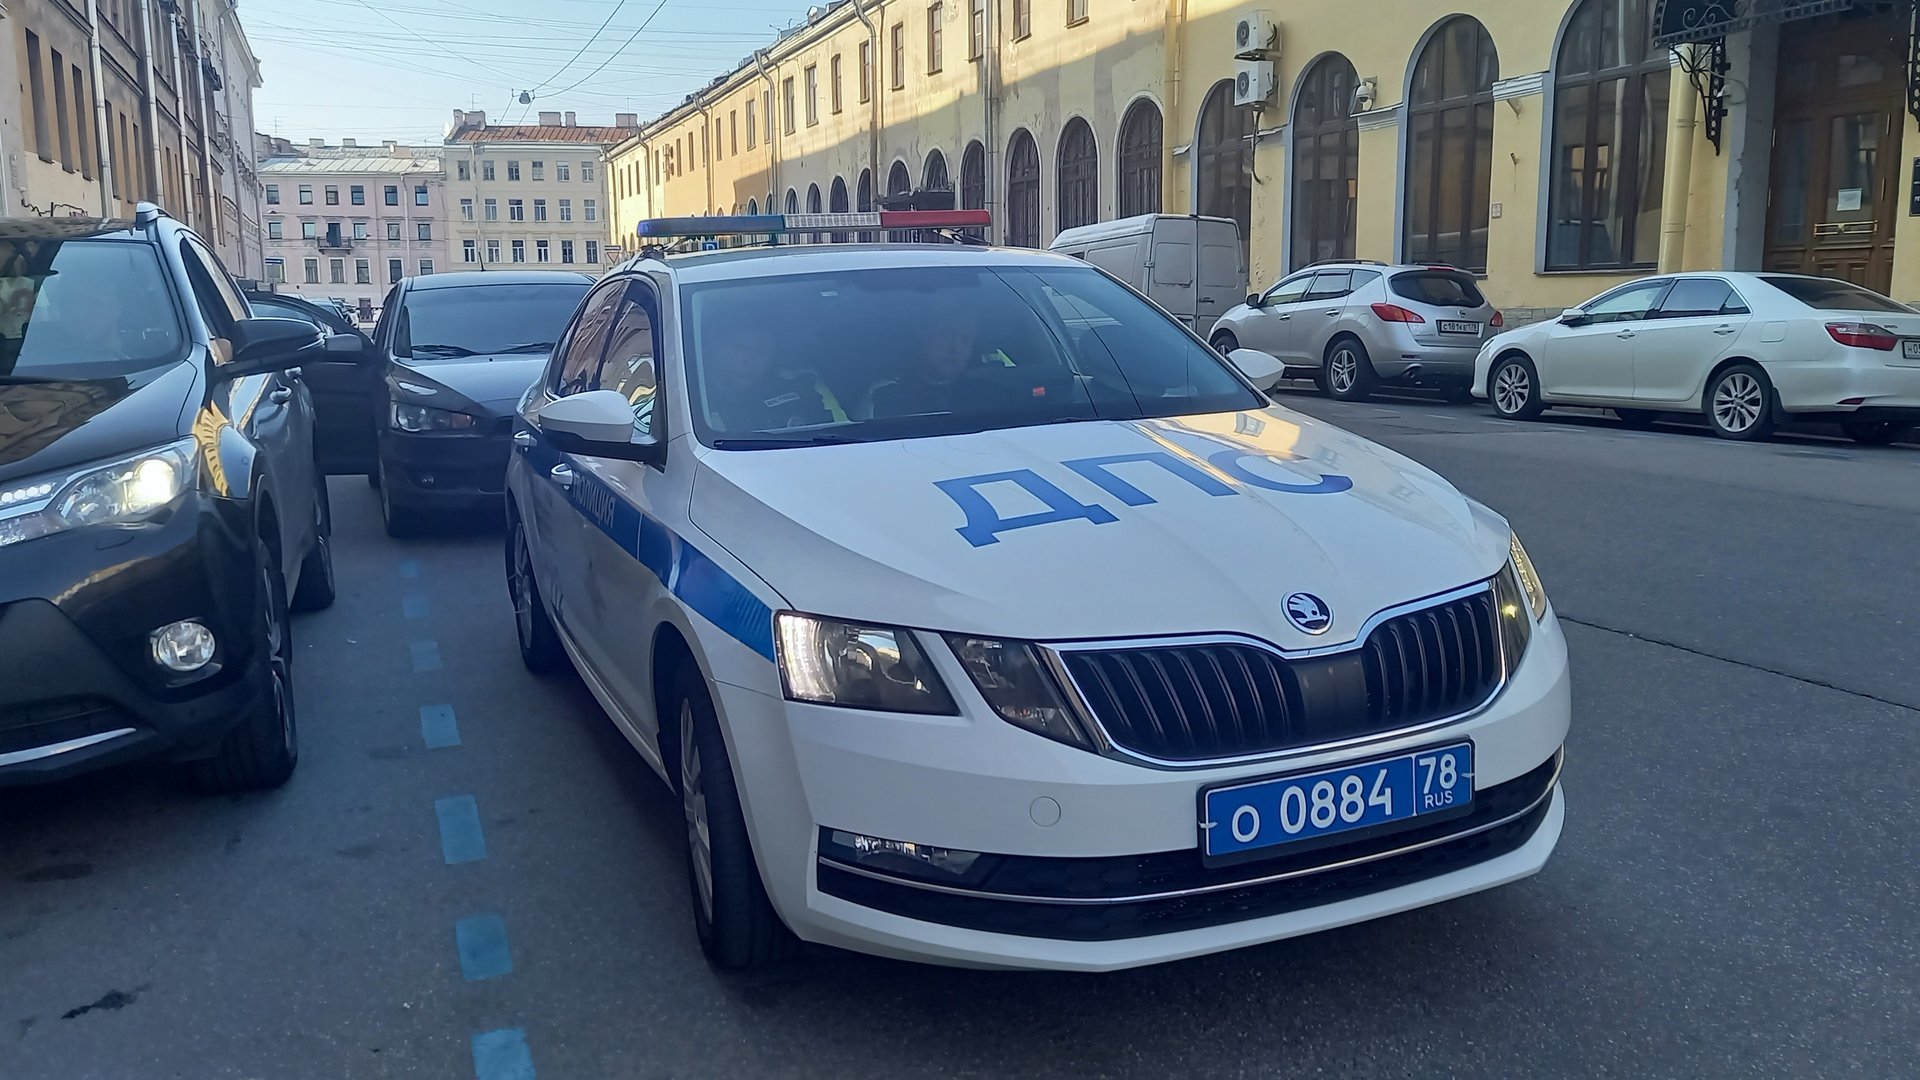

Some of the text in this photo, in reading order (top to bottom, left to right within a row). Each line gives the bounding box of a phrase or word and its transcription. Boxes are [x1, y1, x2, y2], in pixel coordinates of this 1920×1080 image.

[932, 449, 1354, 548] ДПС
[1280, 768, 1393, 834] 0884
[1418, 753, 1458, 794] 78
[1425, 791, 1453, 808] RUS
